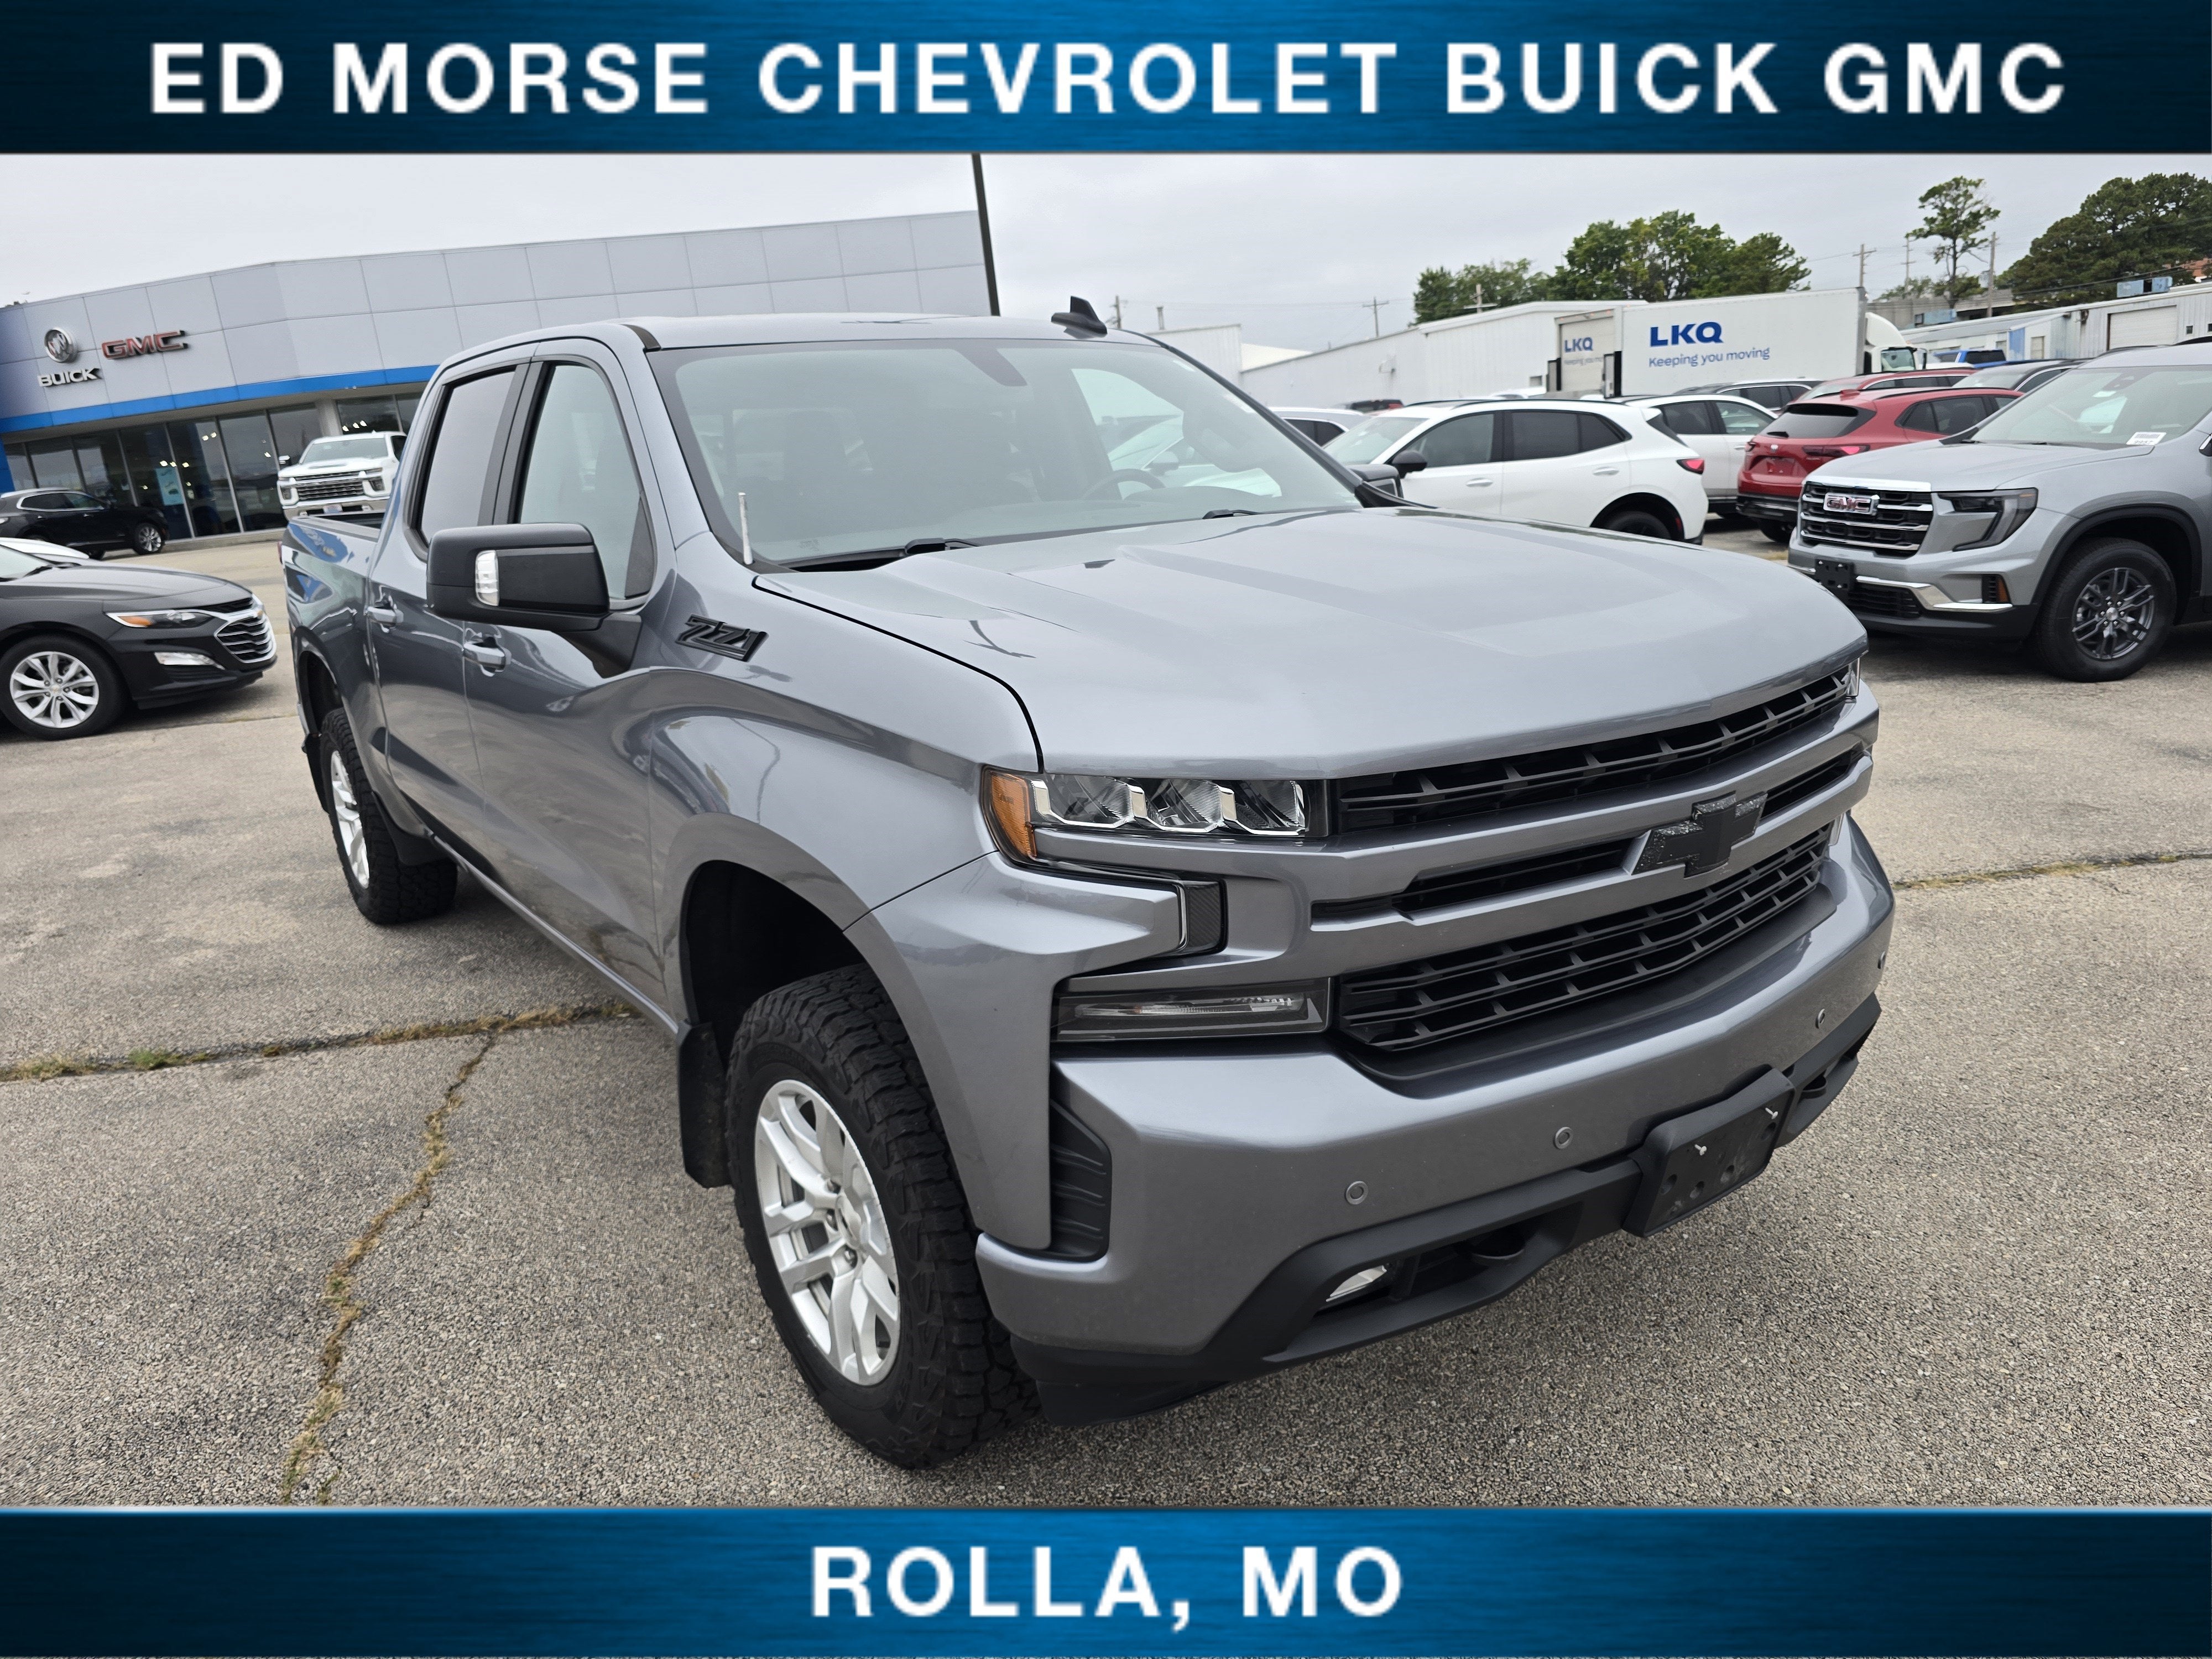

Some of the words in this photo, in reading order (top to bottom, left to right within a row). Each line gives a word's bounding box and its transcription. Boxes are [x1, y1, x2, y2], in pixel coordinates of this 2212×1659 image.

[1650, 321, 1724, 347] LKQ
[102, 331, 182, 359] GMC
[1564, 337, 1593, 352] LKQ
[1649, 353, 1698, 367] Keeping
[1700, 353, 1724, 366] you
[1726, 347, 1770, 360] moving
[38, 367, 98, 387] BUICK
[1827, 496, 1871, 513] GMC
[676, 614, 762, 662] Z71
